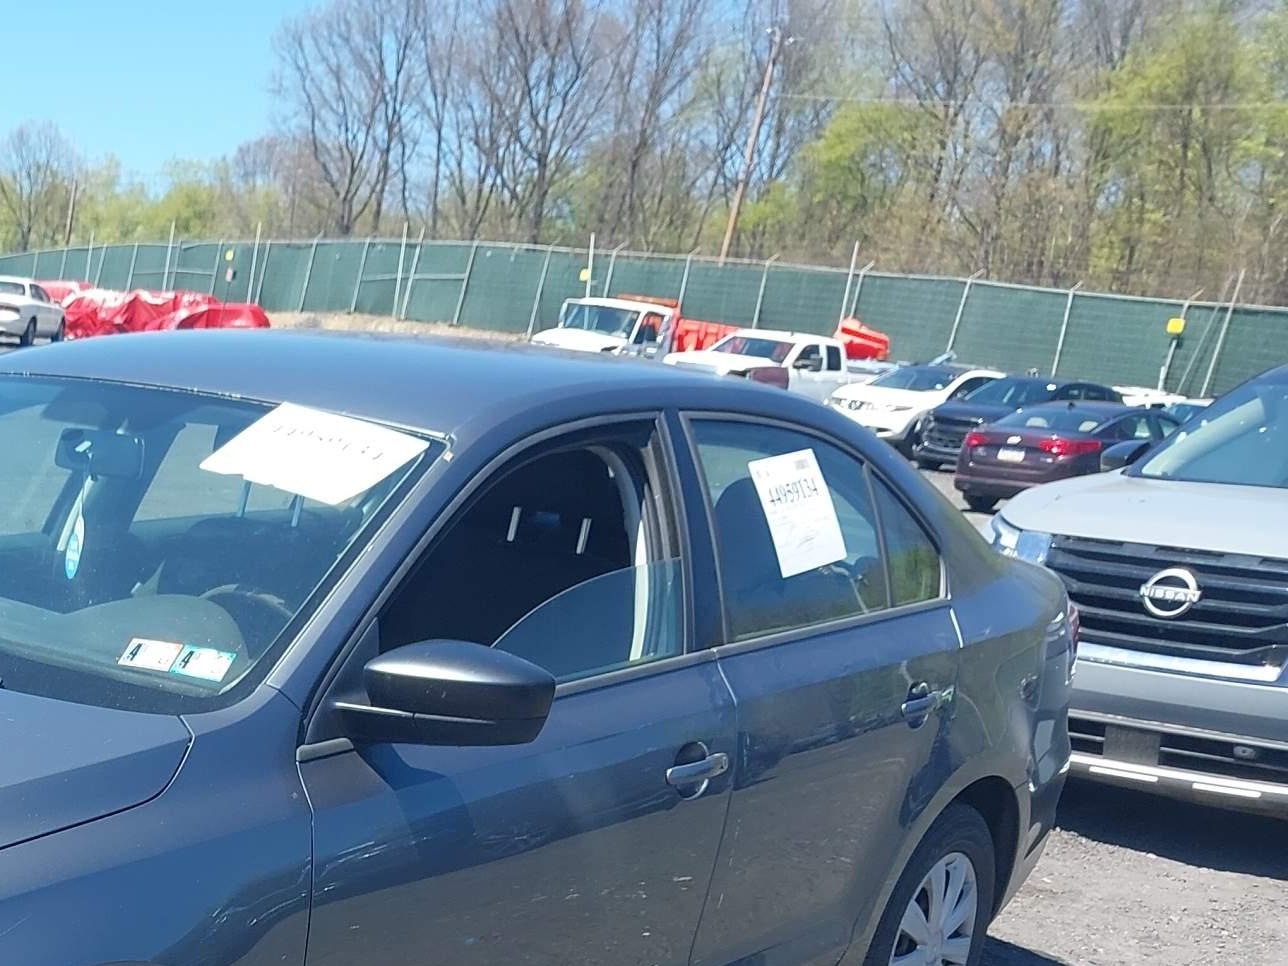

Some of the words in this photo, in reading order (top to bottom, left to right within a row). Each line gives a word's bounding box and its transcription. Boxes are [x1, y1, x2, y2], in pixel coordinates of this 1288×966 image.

[1140, 584, 1201, 602] NISSAN
[126, 643, 143, 661] 4
[178, 650, 195, 669] 4
